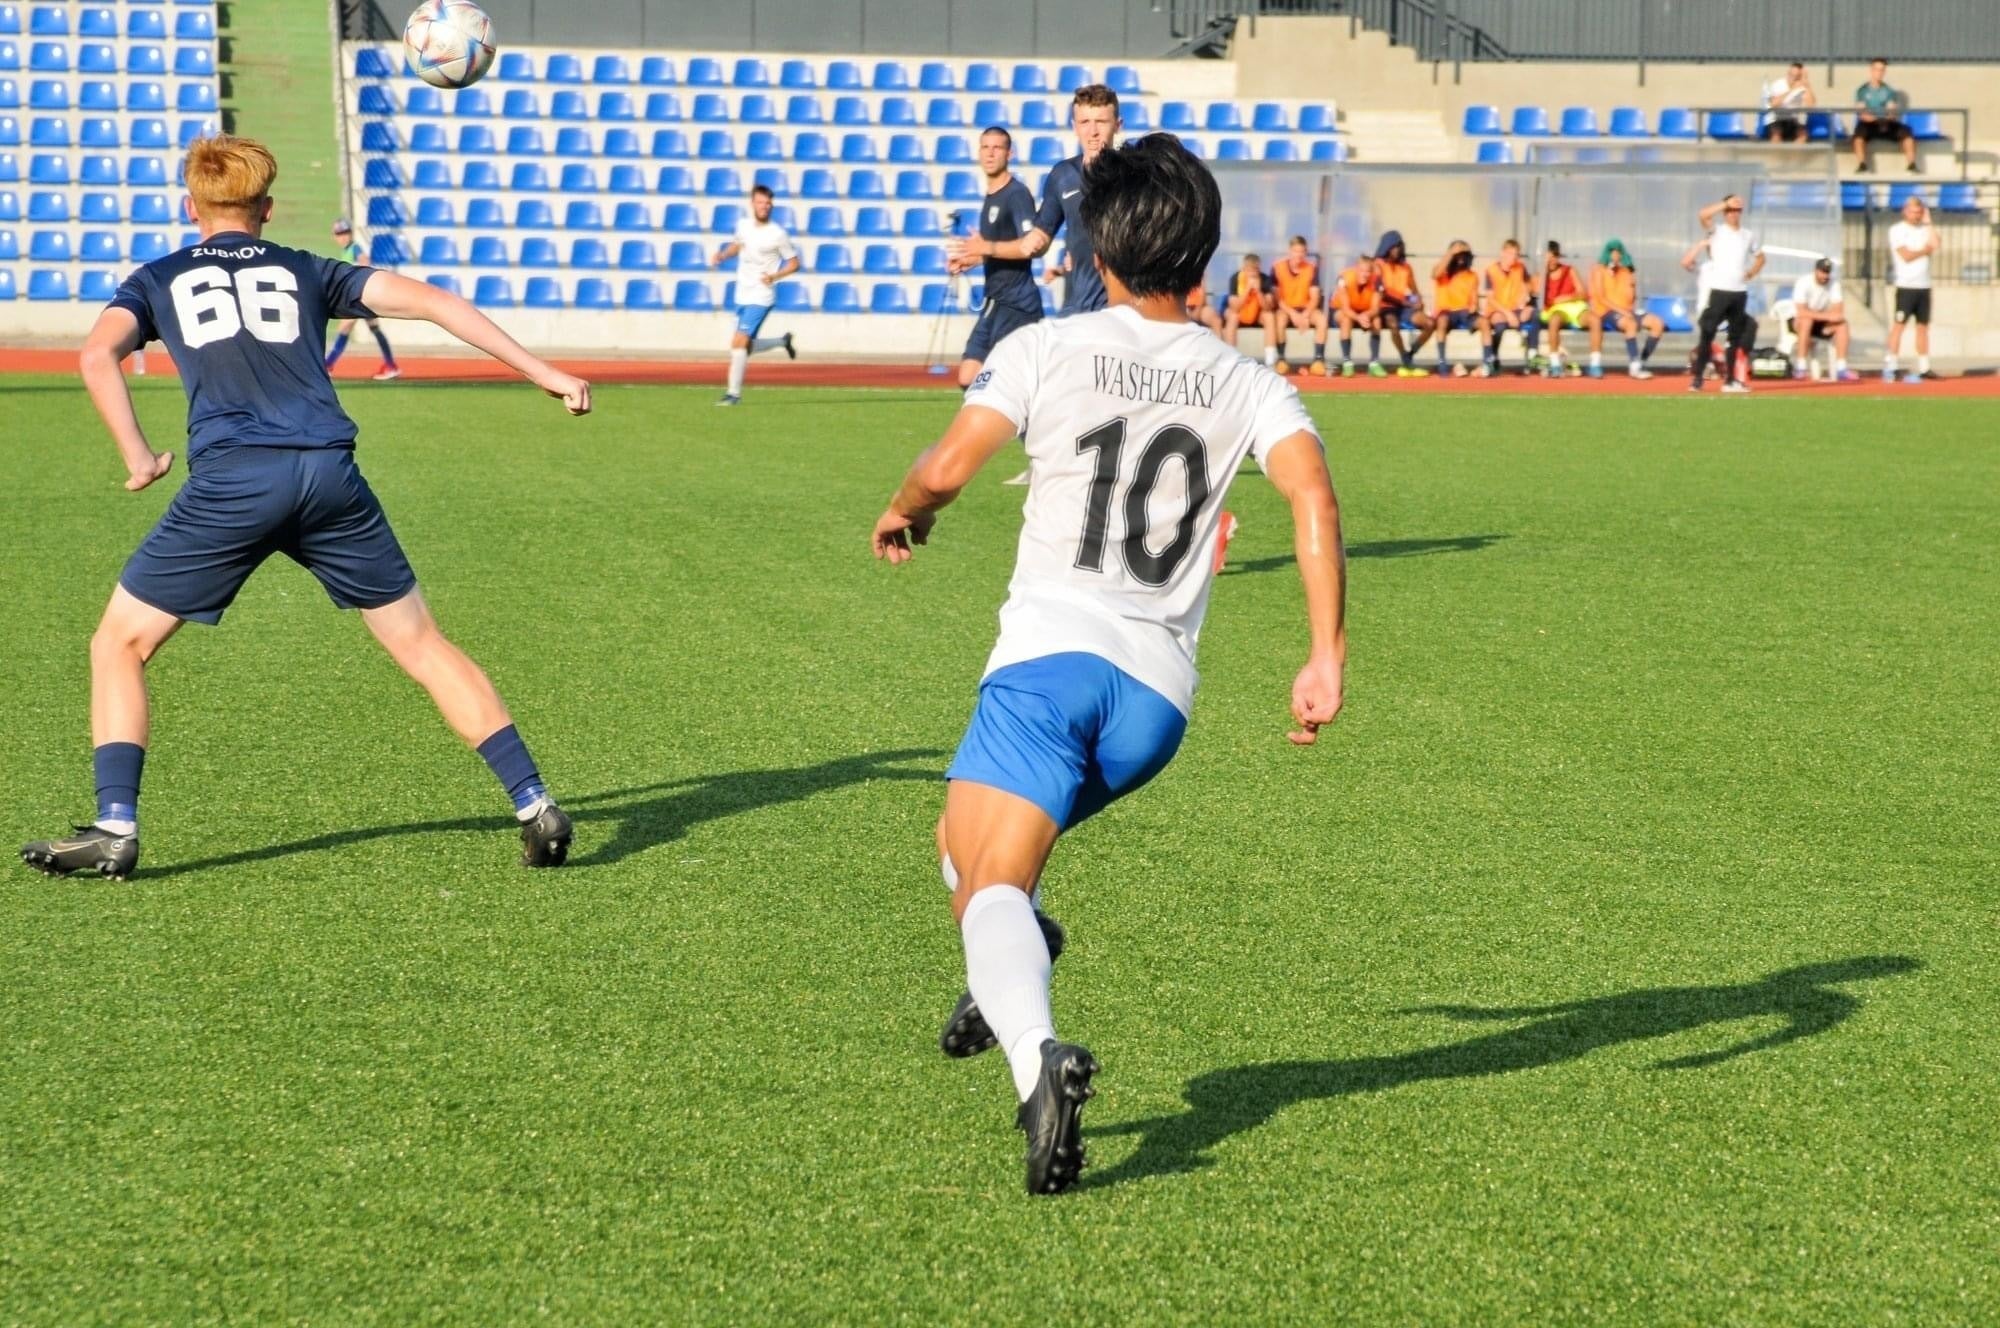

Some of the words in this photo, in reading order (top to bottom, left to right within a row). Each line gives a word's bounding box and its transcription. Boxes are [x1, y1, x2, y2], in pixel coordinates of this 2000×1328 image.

[170, 265, 300, 349] 66
[1093, 354, 1215, 409] WASHIZAKI
[1073, 416, 1212, 588] 10
